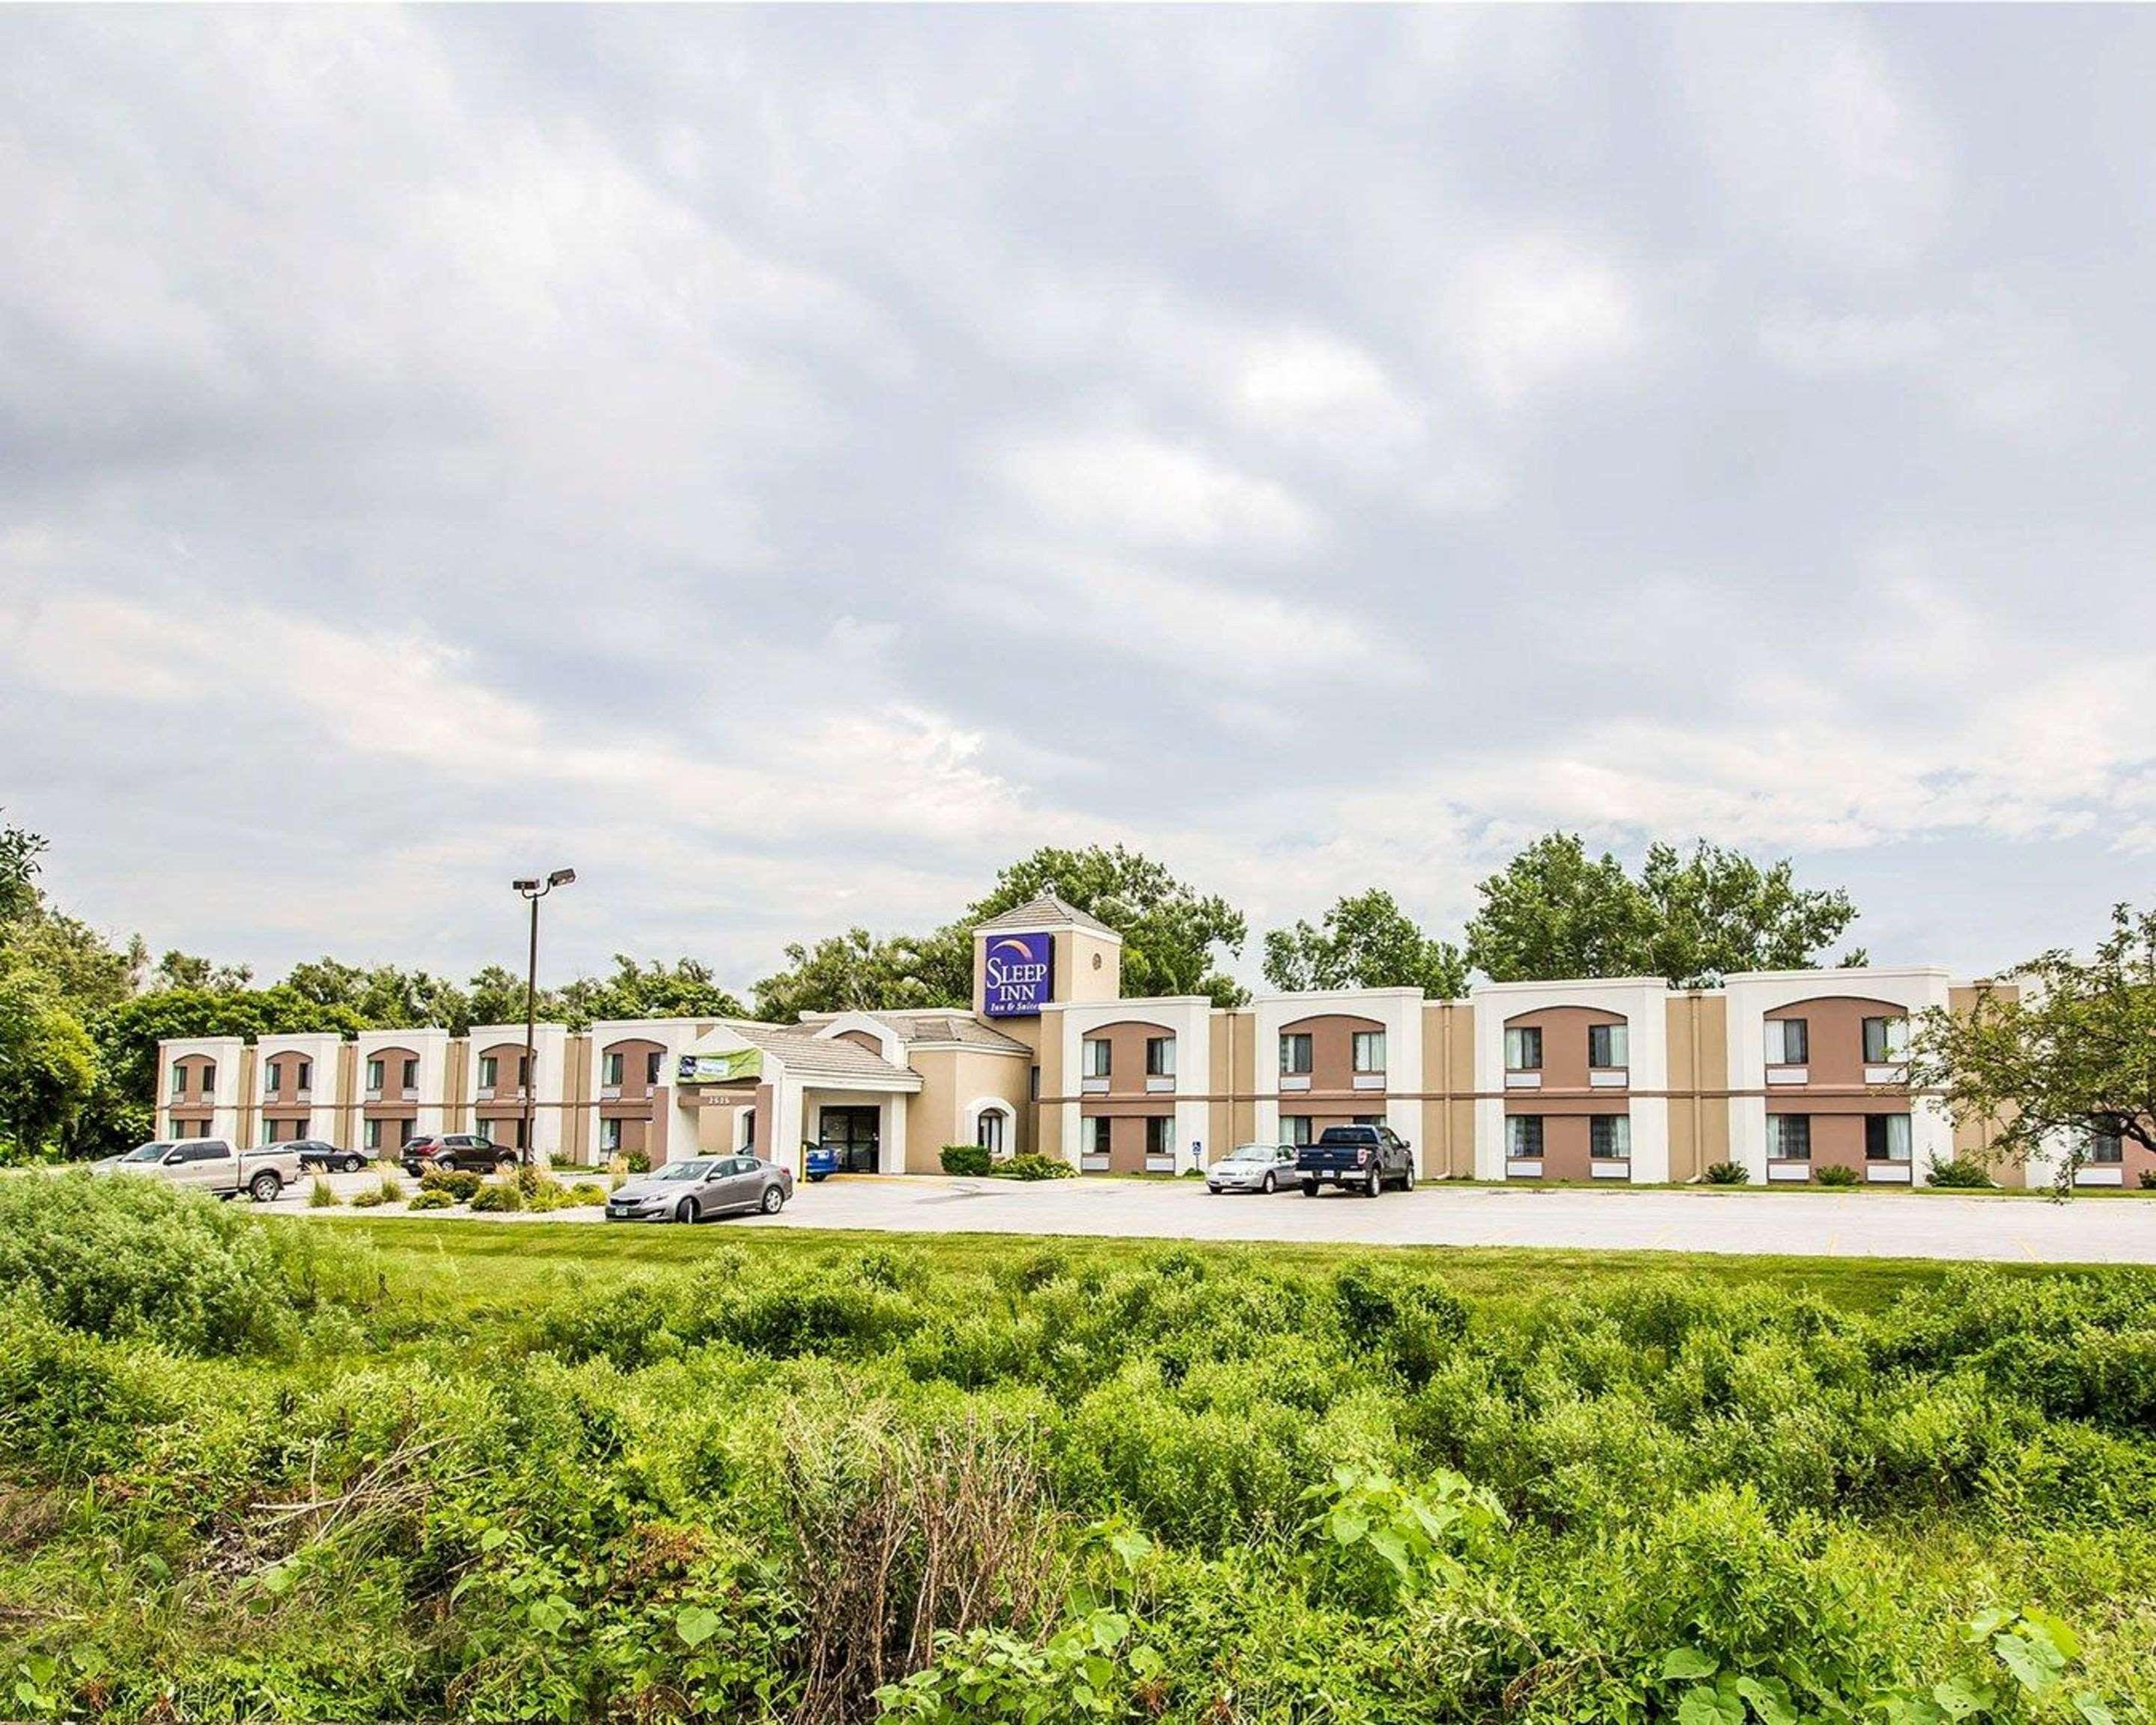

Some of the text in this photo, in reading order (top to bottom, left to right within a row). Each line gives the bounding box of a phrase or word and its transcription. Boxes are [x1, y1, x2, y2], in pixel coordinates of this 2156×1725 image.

[987, 957, 1047, 989] SLEEP
[999, 985, 1035, 1001] INN
[1007, 1003, 1014, 1011] &
